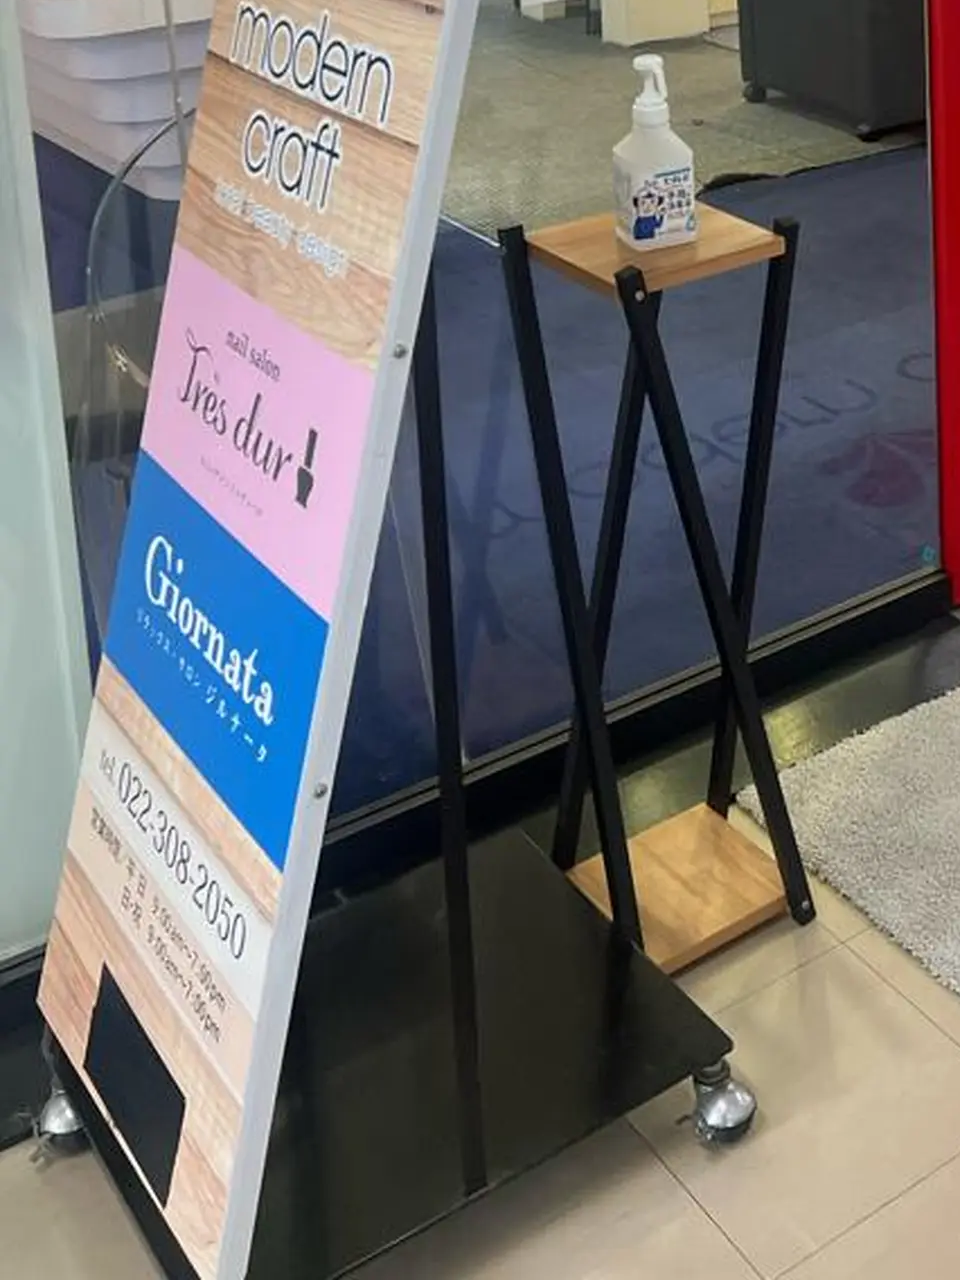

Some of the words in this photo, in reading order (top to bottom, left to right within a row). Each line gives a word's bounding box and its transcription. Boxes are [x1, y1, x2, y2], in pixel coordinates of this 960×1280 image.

[230, 5, 393, 124] modern
[243, 113, 341, 210] craft
[226, 330, 250, 359] nail
[248, 346, 282, 383] salon
[145, 535, 275, 727] Giornata
[117, 761, 248, 961] 022-308-2050
